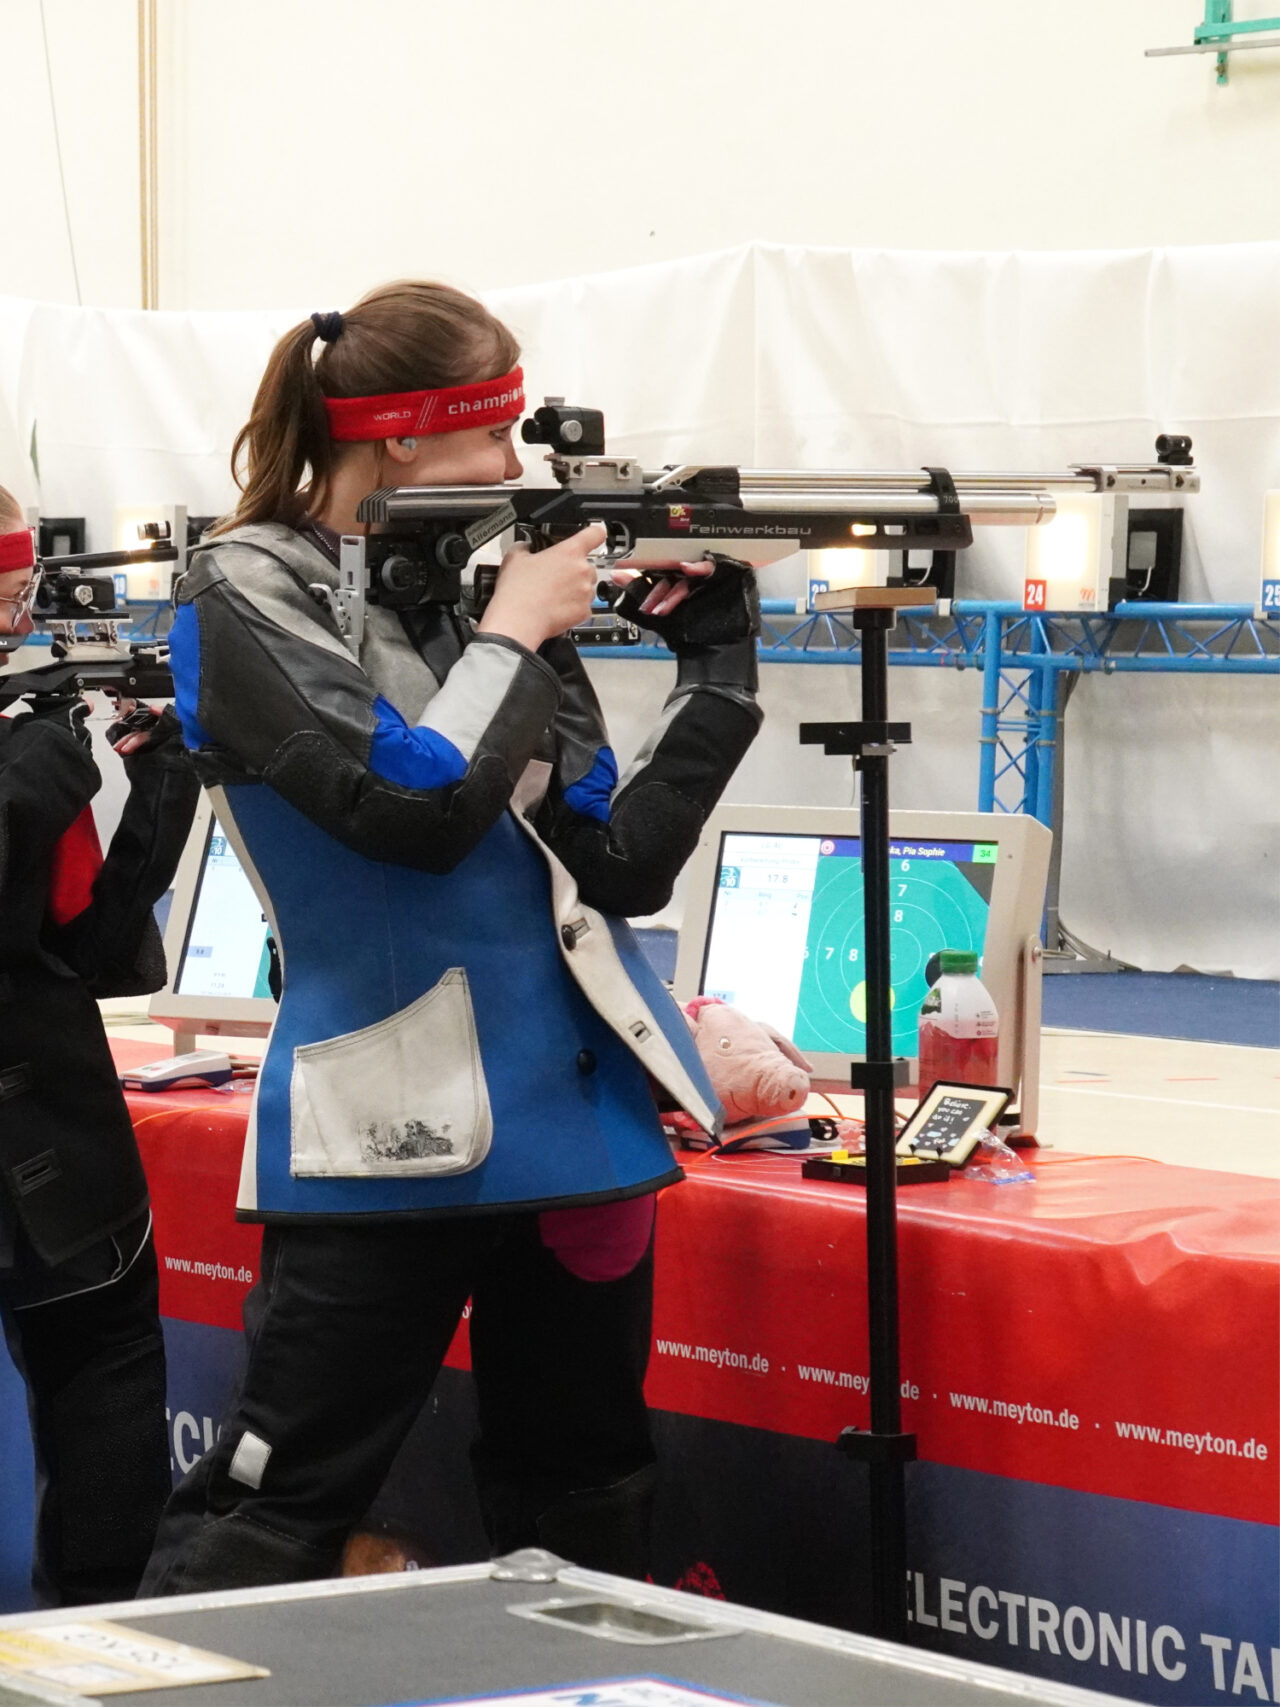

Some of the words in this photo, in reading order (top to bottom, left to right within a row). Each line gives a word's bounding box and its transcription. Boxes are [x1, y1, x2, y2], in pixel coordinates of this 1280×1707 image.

[373, 410, 412, 421] WORLD
[689, 523, 812, 536] Feinwerkbau
[1026, 583, 1044, 606] 24
[900, 859, 910, 872] 6
[897, 884, 908, 897] 7
[893, 910, 904, 923] 8
[825, 947, 835, 960] 7
[848, 948, 859, 962] 8
[164, 1255, 253, 1284] www.meyton.de
[656, 1339, 769, 1374] www.meyton.de
[949, 1391, 1080, 1431] www.meyton.de
[1114, 1420, 1269, 1461] www.meyton.de
